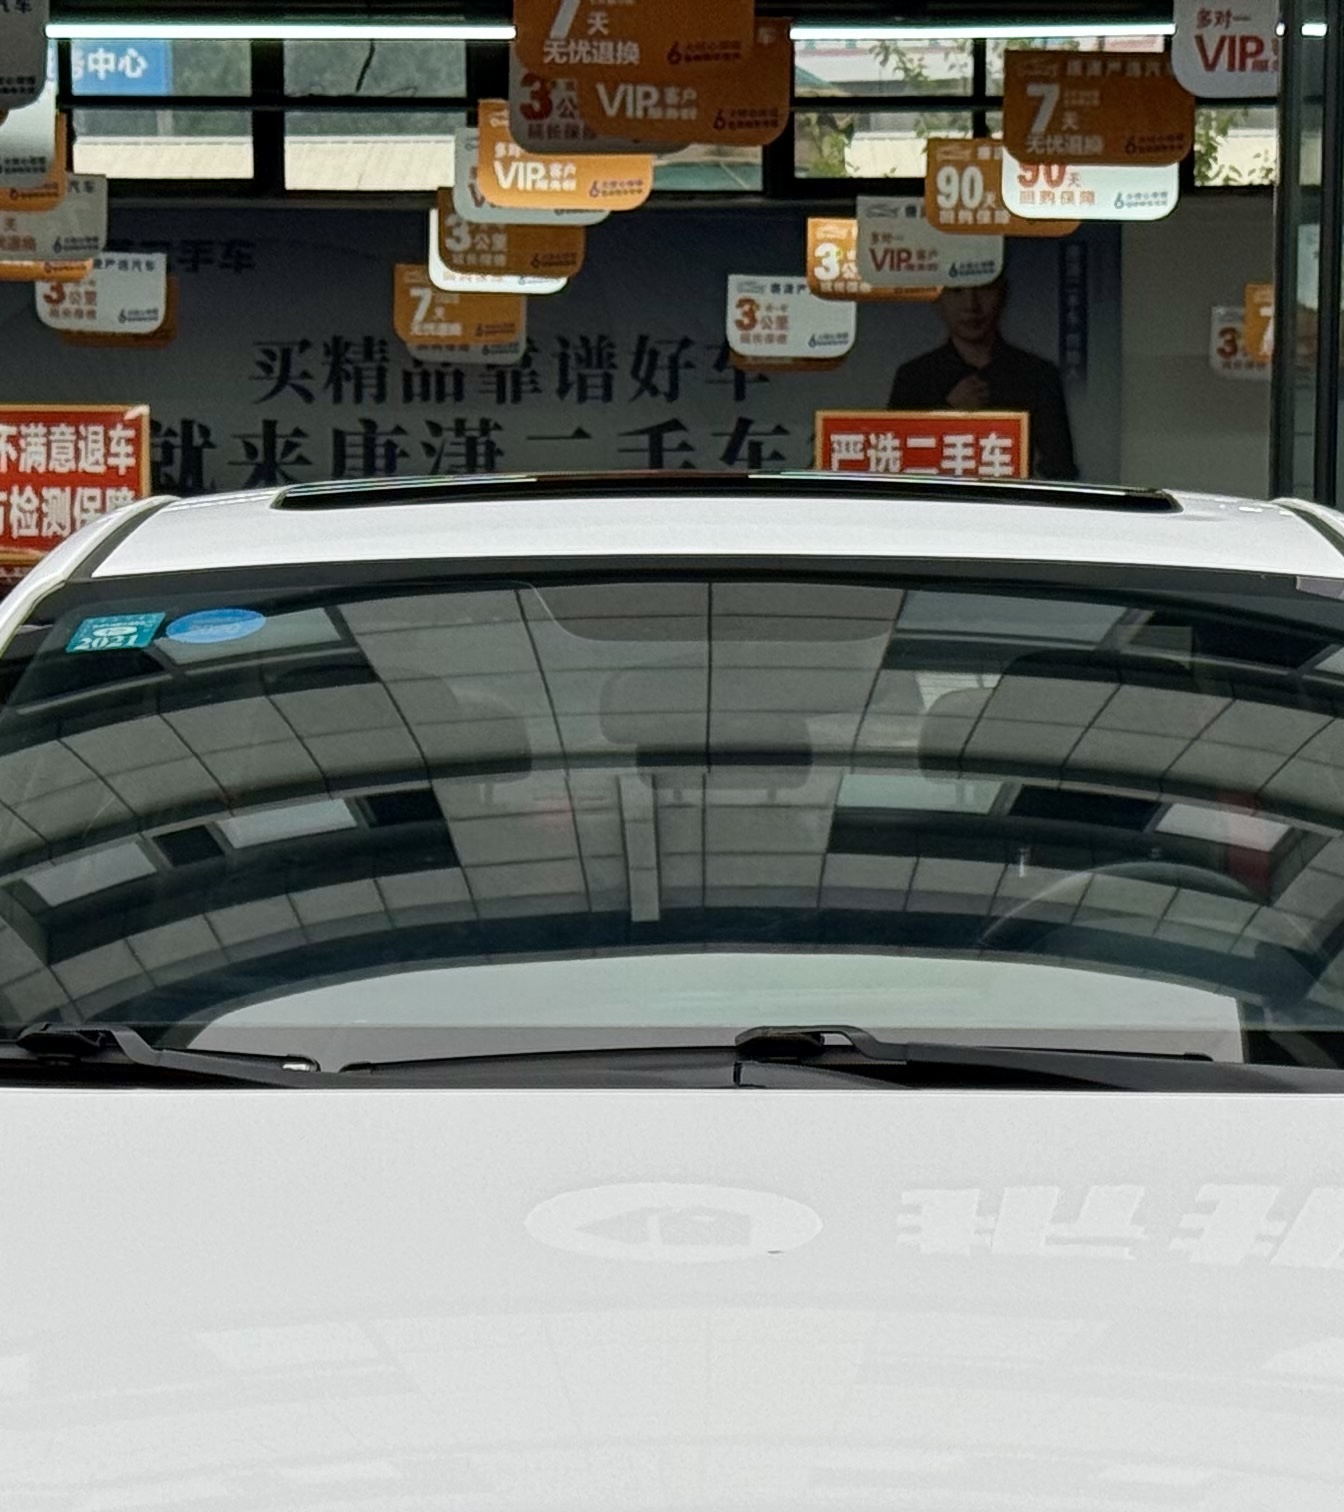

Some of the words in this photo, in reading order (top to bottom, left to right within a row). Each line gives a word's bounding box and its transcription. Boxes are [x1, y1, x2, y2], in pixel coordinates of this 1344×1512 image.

[1197, 8, 1251, 29] 多对一
[544, 40, 640, 65] 无忧退换
[667, 41, 681, 65] 6
[1194, 34, 1264, 73] VIP
[520, 73, 553, 121] 3
[596, 83, 659, 119] VIP
[664, 87, 697, 105] 客户
[1026, 135, 1103, 154] 无忧退换
[493, 161, 545, 191] VIP
[1019, 191, 1096, 206] 回购保障
[1114, 192, 1125, 210] 6
[445, 213, 471, 252] 3
[814, 243, 840, 280] 3
[868, 248, 912, 272] VIP
[735, 297, 757, 331] 3
[760, 316, 789, 332] 公里
[1216, 327, 1239, 359] 3
[829, 432, 1015, 477] 严选二手车
[74, 636, 138, 650] 2021
